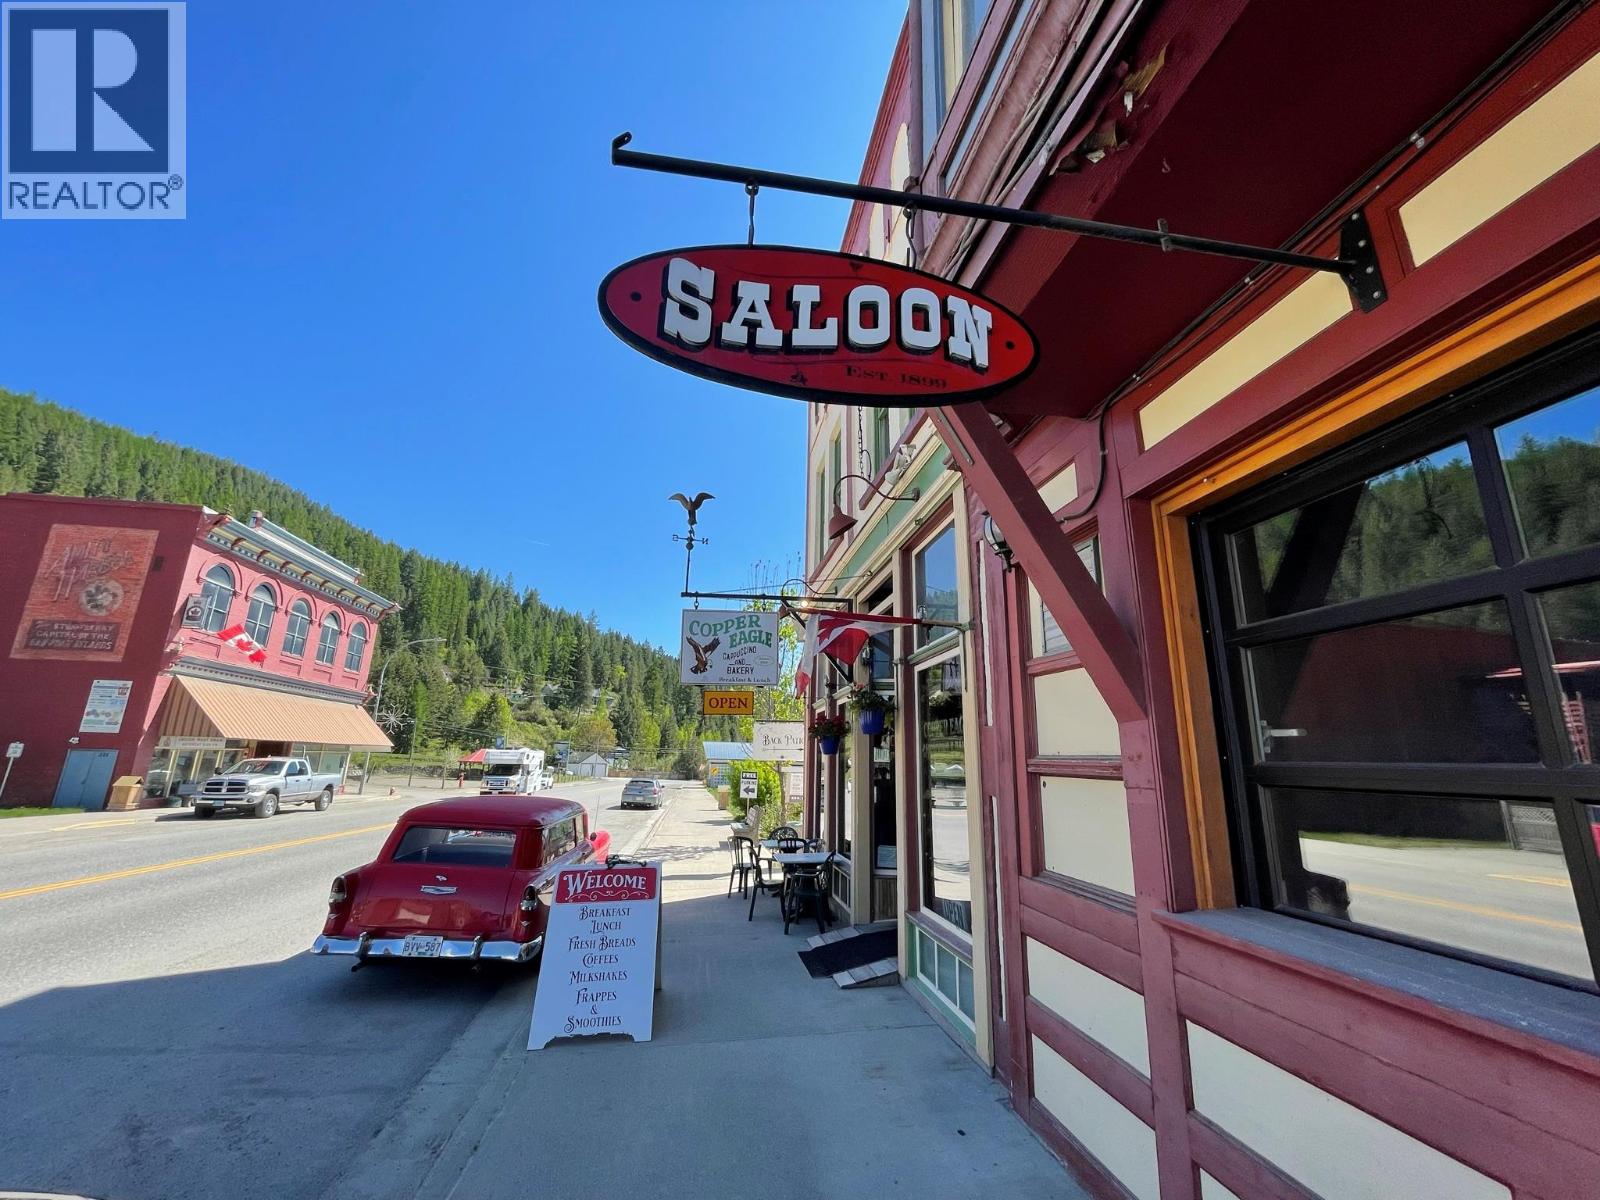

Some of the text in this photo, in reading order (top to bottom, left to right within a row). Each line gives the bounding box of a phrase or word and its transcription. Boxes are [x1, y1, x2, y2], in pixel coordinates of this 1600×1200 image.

[661, 256, 993, 373] SALOON
[688, 615, 761, 637] COPPER
[729, 630, 772, 648] EAGLE
[726, 666, 755, 675] BAKERY
[708, 697, 748, 709] OPEN
[563, 871, 647, 900] WELCOME
[579, 906, 632, 920] BREAKFAST
[590, 921, 622, 934] LUNCH
[568, 936, 637, 951] FRESH BREADS
[582, 954, 619, 968] COFFEES
[569, 970, 629, 986] MILKSHAKES
[576, 988, 617, 1004] FRAPPES
[590, 1004, 598, 1015] &
[564, 1015, 623, 1034] SMOOTHIES
